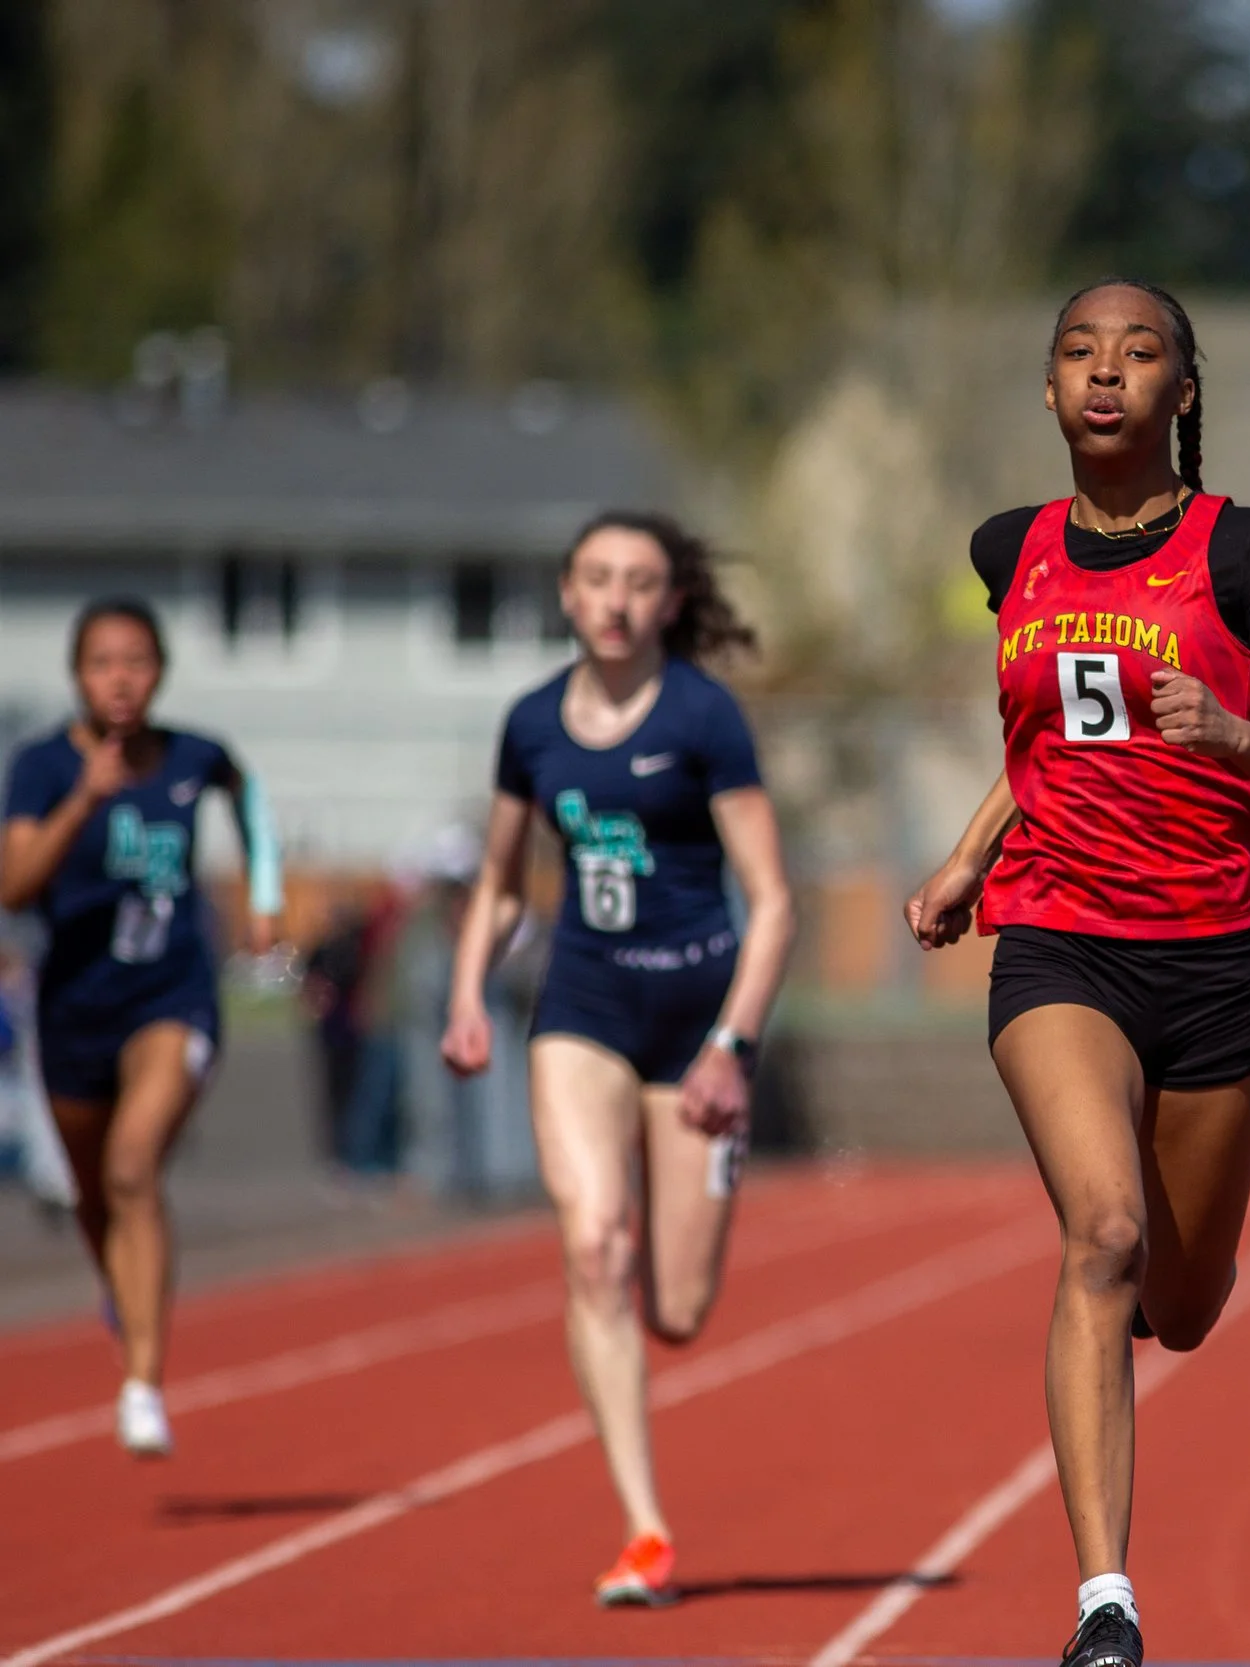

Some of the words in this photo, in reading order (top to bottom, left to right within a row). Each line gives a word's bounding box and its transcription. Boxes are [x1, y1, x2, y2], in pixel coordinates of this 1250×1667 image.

[1001, 618, 1045, 673] MT.
[1054, 612, 1183, 671] TAHOMA
[1074, 659, 1116, 737] 5
[593, 868, 621, 925] 6
